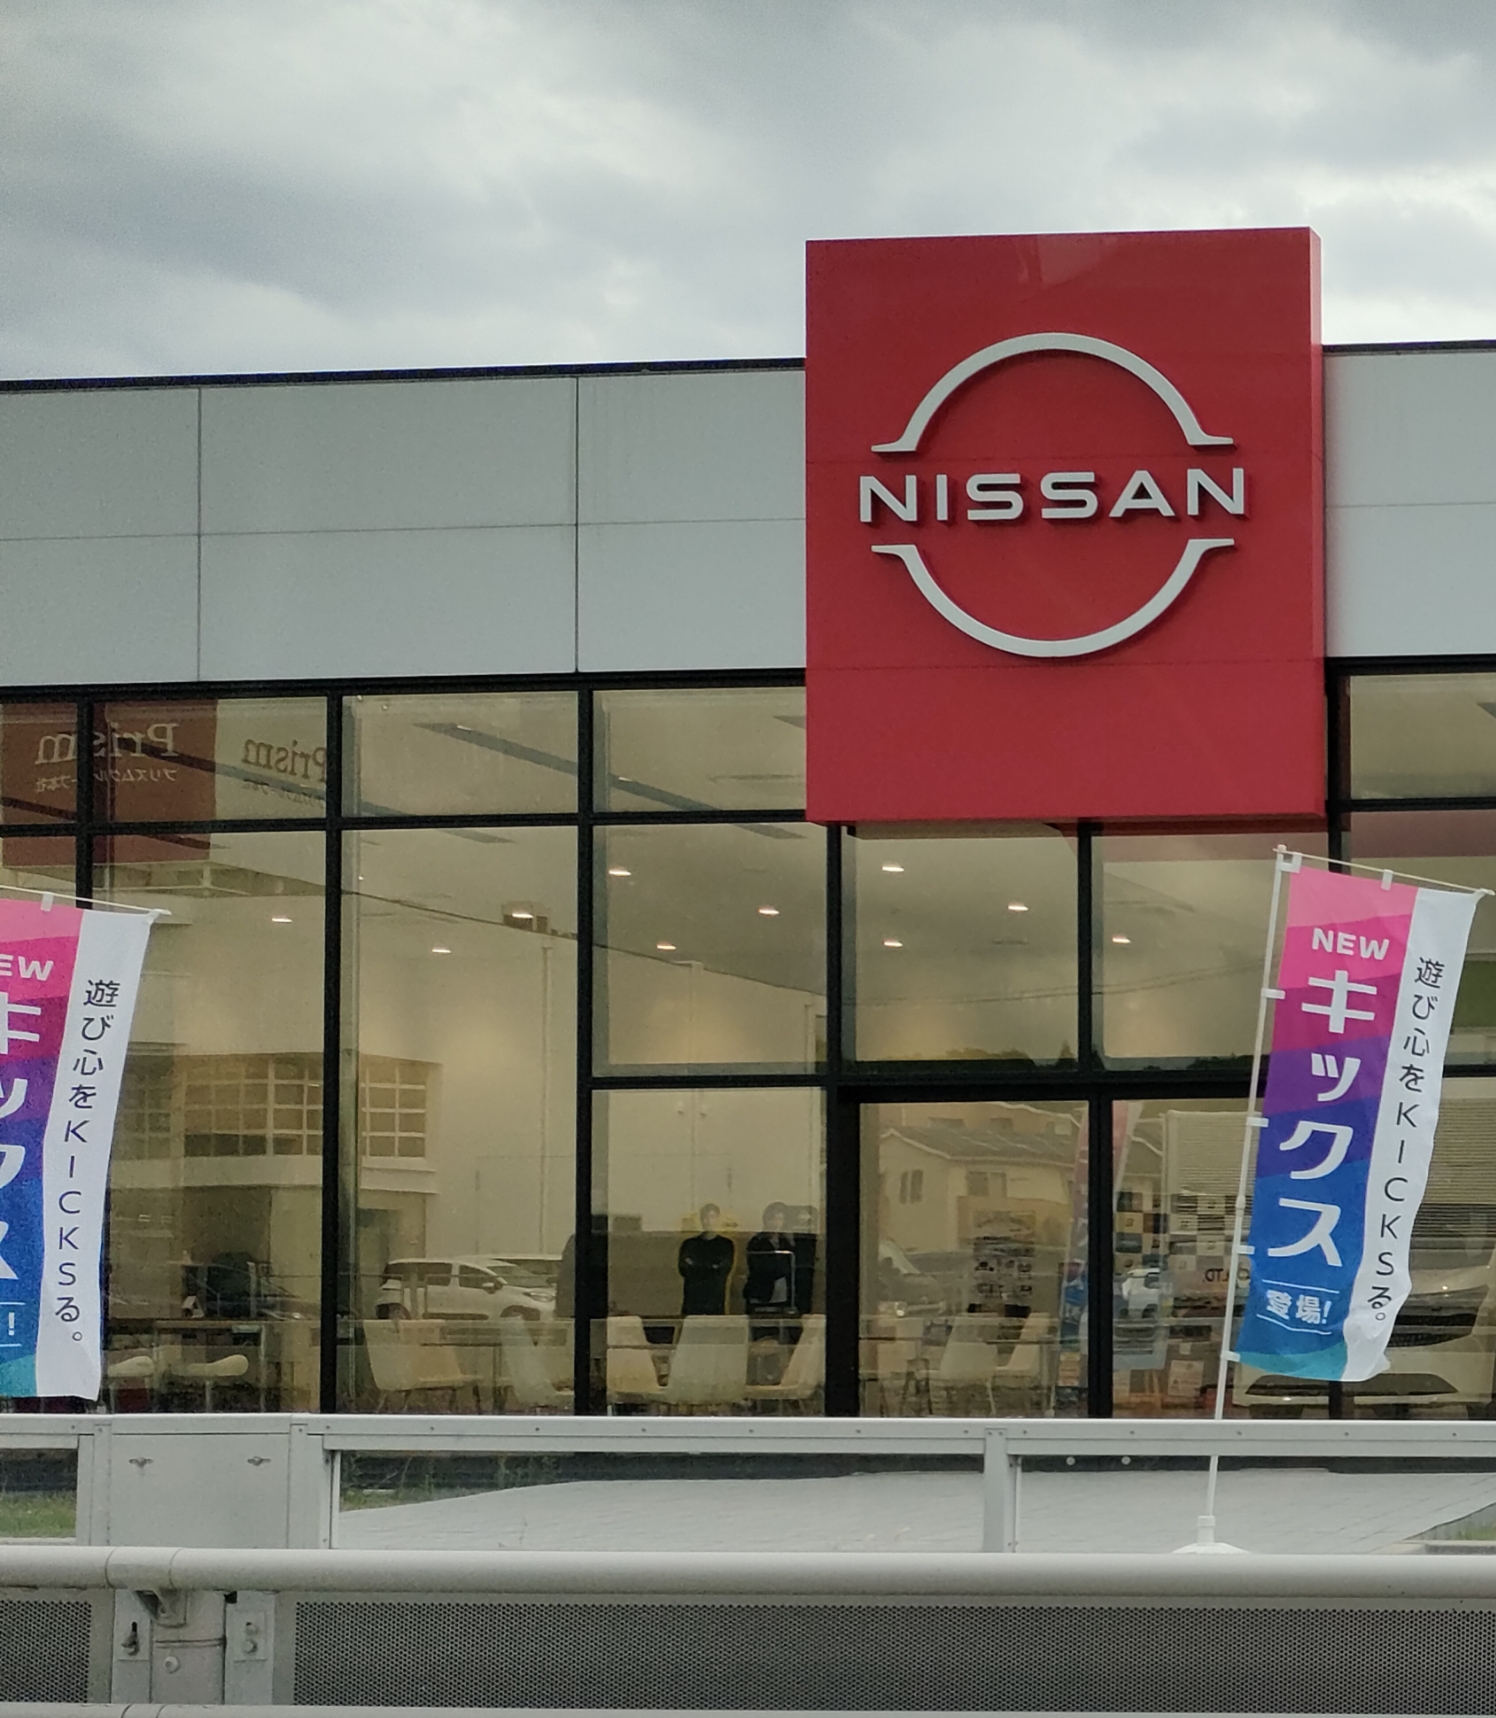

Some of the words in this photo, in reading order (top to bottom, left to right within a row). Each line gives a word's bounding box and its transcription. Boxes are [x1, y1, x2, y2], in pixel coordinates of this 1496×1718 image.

[859, 467, 1245, 523] NISSAN
[1310, 929, 1390, 961] NEW
[54, 979, 120, 1343] 遊び心をKICKSる。
[1266, 970, 1378, 1268] キックス
[1366, 956, 1446, 1322] 遊び心をKICKSる。
[1265, 1288, 1332, 1327] 登場!
